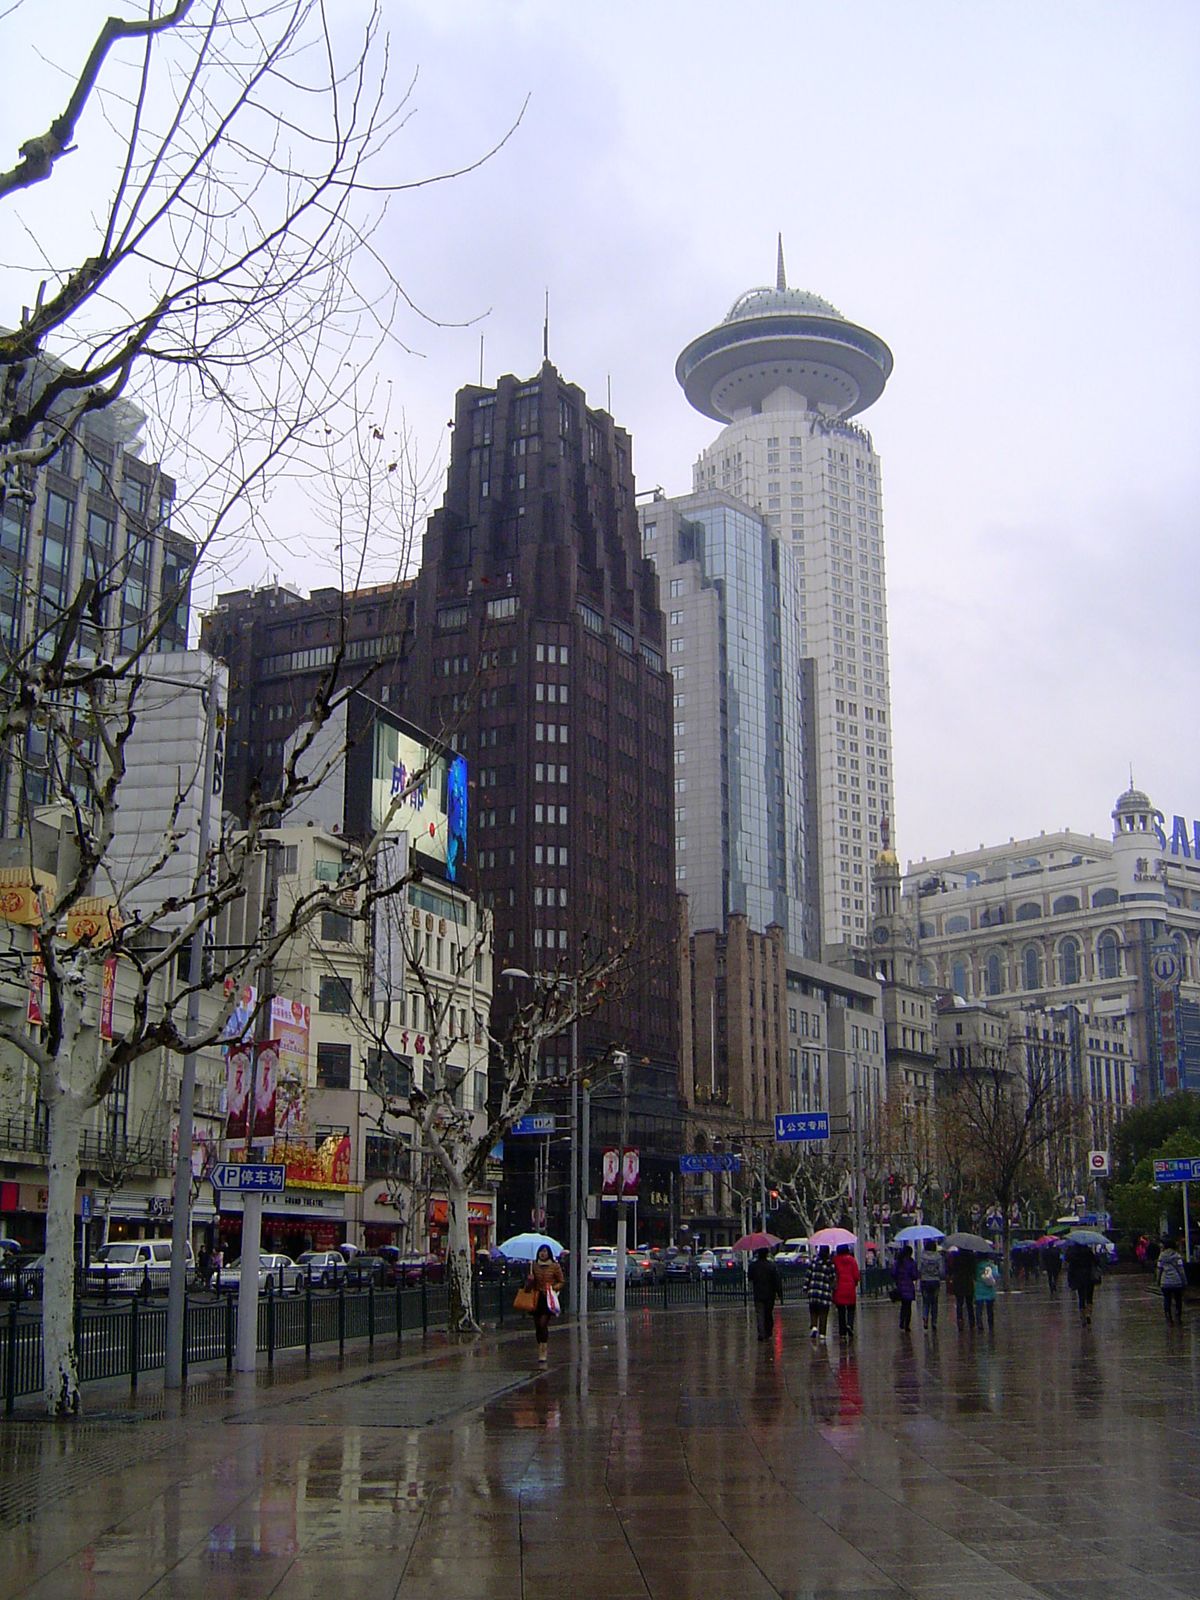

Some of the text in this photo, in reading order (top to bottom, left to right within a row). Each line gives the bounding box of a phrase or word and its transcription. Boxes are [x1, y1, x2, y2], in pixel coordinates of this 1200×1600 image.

[786, 1120, 827, 1132] 公交专用
[227, 1169, 282, 1186] P 停车场
